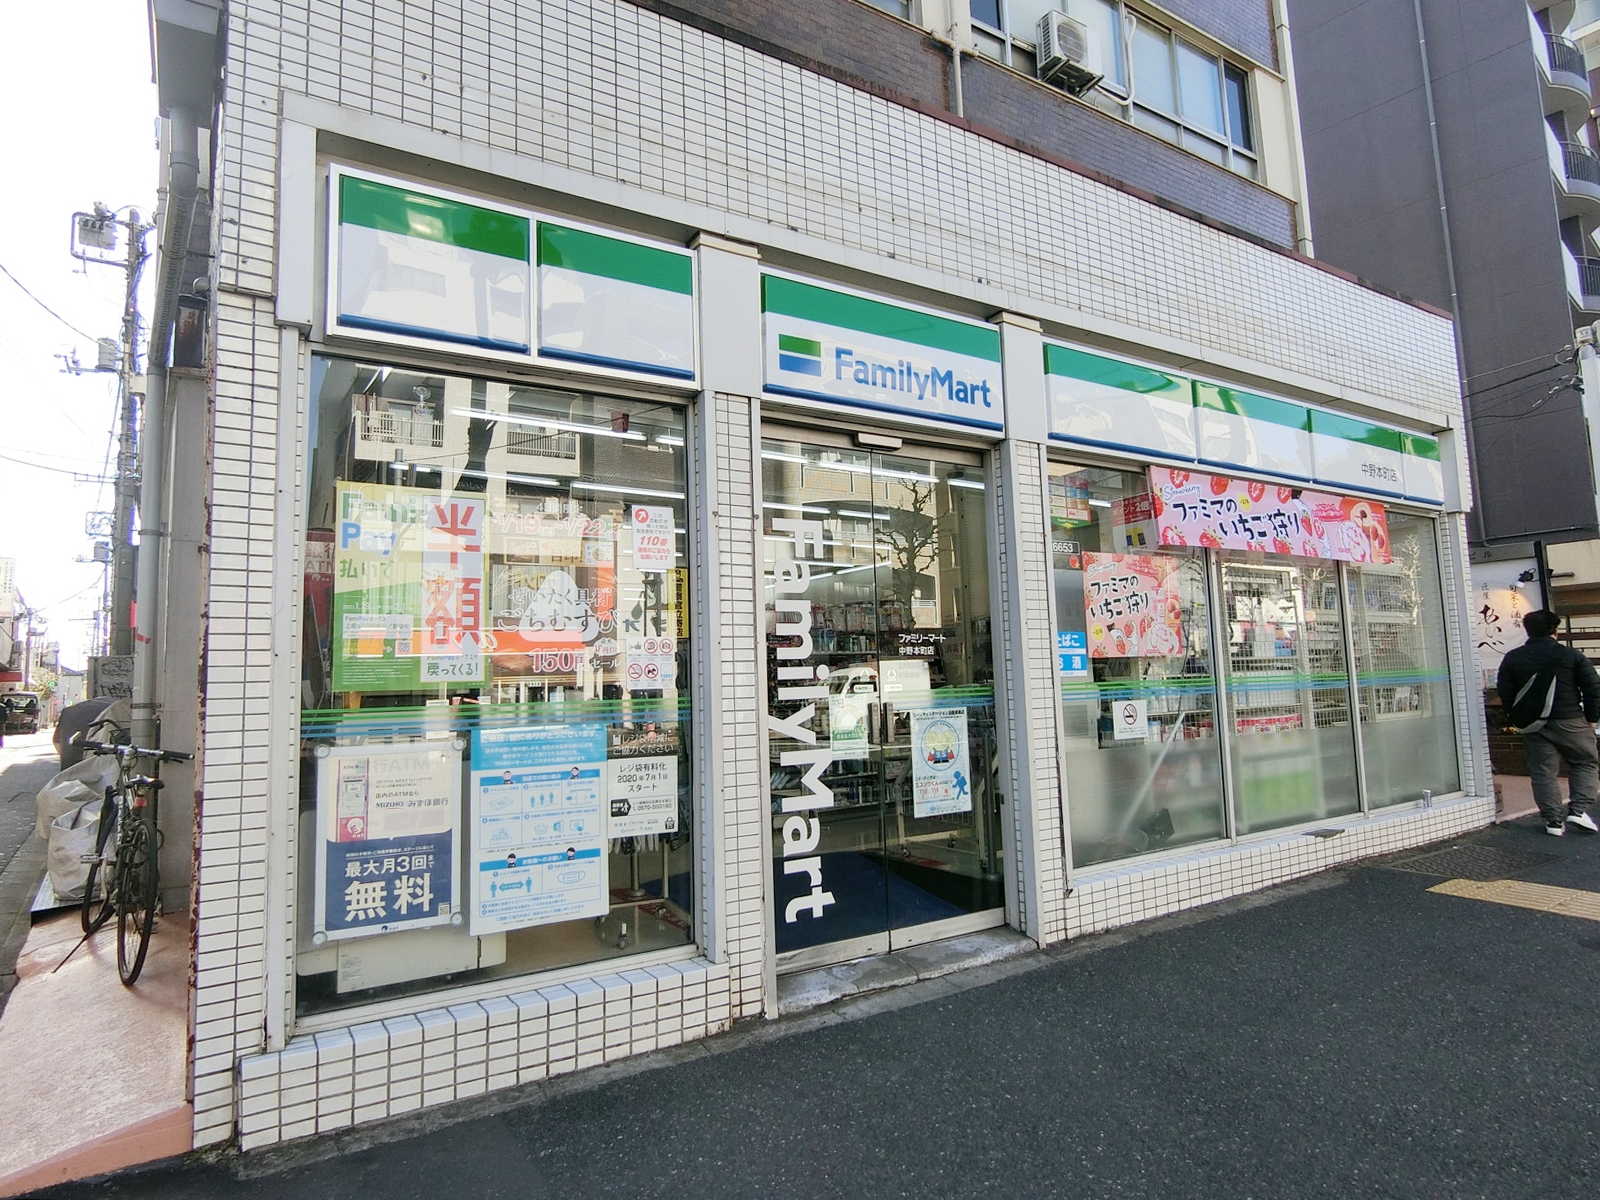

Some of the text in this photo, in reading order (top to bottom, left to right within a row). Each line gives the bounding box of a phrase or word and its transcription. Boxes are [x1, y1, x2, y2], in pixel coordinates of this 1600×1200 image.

[835, 346, 992, 408] FamilyMart
[1361, 462, 1398, 482] 中野本町店
[1163, 480, 1202, 502] Strawberry
[1172, 497, 1238, 524] ファミマの
[1218, 508, 1300, 541] いちご狩り
[341, 522, 398, 556] Pay
[640, 535, 668, 546] 110番
[425, 502, 482, 646] 半額
[1090, 575, 1139, 598] ファミマの
[508, 587, 613, 607] ぜいたく具材
[1090, 590, 1149, 620] いちご狩り
[497, 607, 622, 634] ごちむすび
[898, 633, 947, 644] ファミリーマート
[898, 646, 935, 656] 中野本町店
[427, 662, 478, 676] 戻ってくる!
[590, 657, 621, 669] セール
[767, 517, 837, 925] FamilyMart
[613, 743, 674, 756] ご協力ください
[616, 772, 668, 783] 2020年7月1日
[619, 762, 667, 773] レジ袋有料化
[628, 783, 658, 793] スタート
[407, 798, 449, 808] みずほ銀行
[344, 872, 435, 923] 無料
